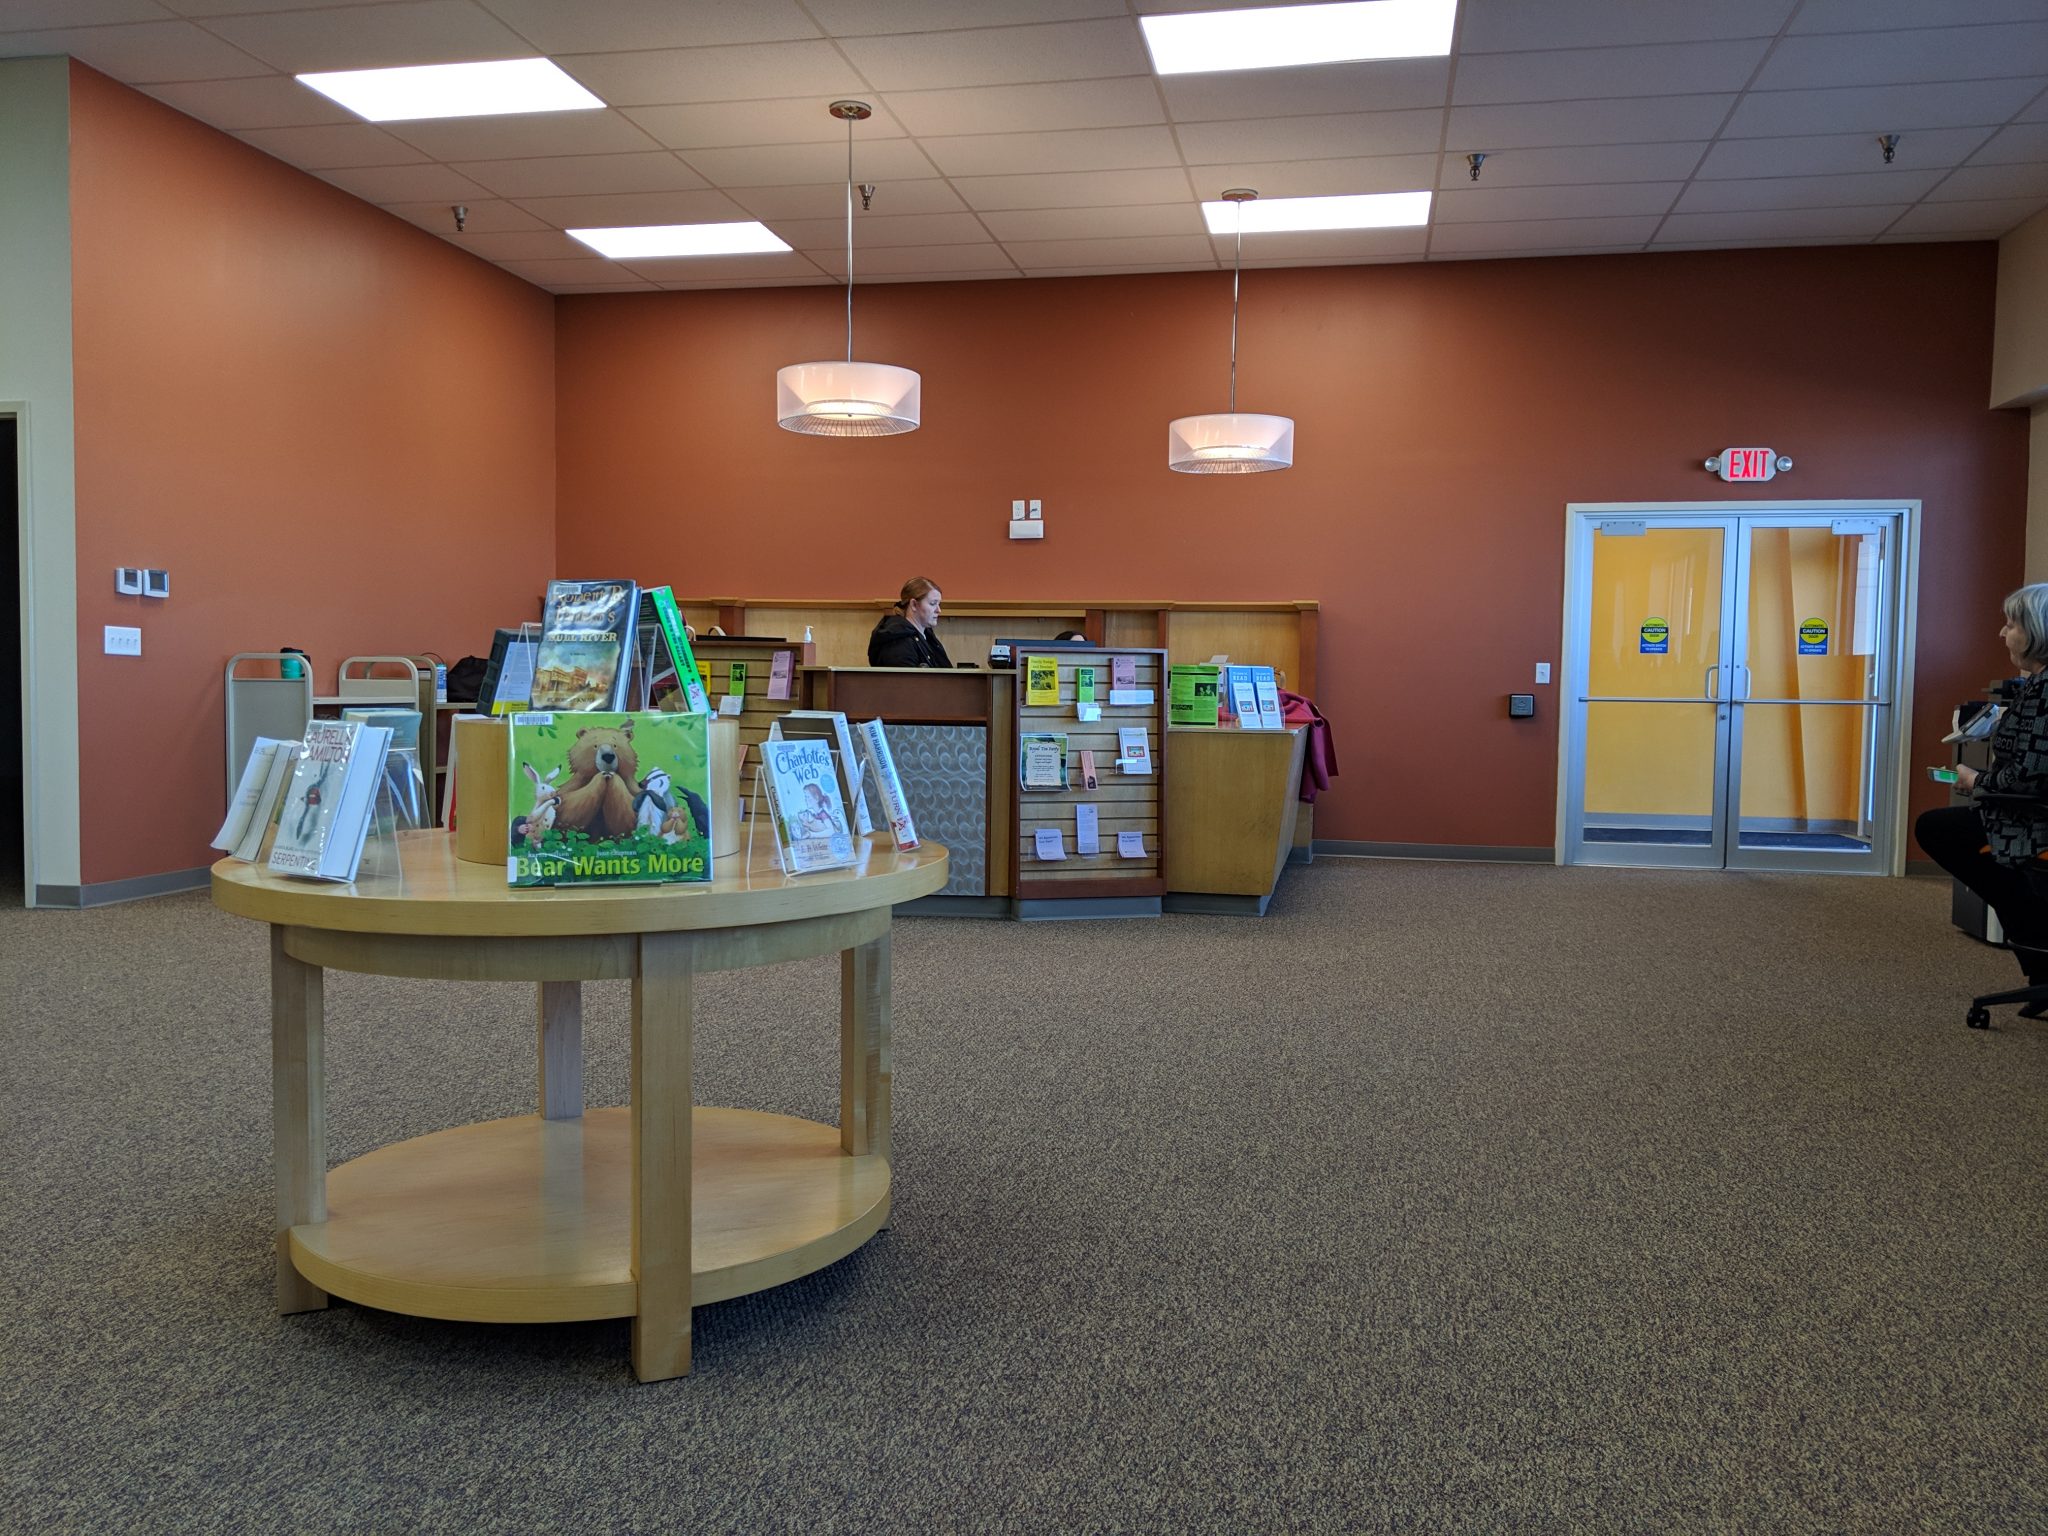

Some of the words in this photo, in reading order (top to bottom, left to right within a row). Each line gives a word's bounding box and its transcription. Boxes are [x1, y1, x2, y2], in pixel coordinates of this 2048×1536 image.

[1729, 451, 1770, 478] EXIT
[579, 632, 618, 642] RIVER
[776, 747, 830, 774] Charlotte's
[868, 726, 877, 738] KIM
[873, 738, 888, 770] HARRISON
[793, 764, 819, 784] Web
[517, 855, 566, 877] Bear
[573, 857, 641, 876] Wants
[648, 854, 705, 873] More
